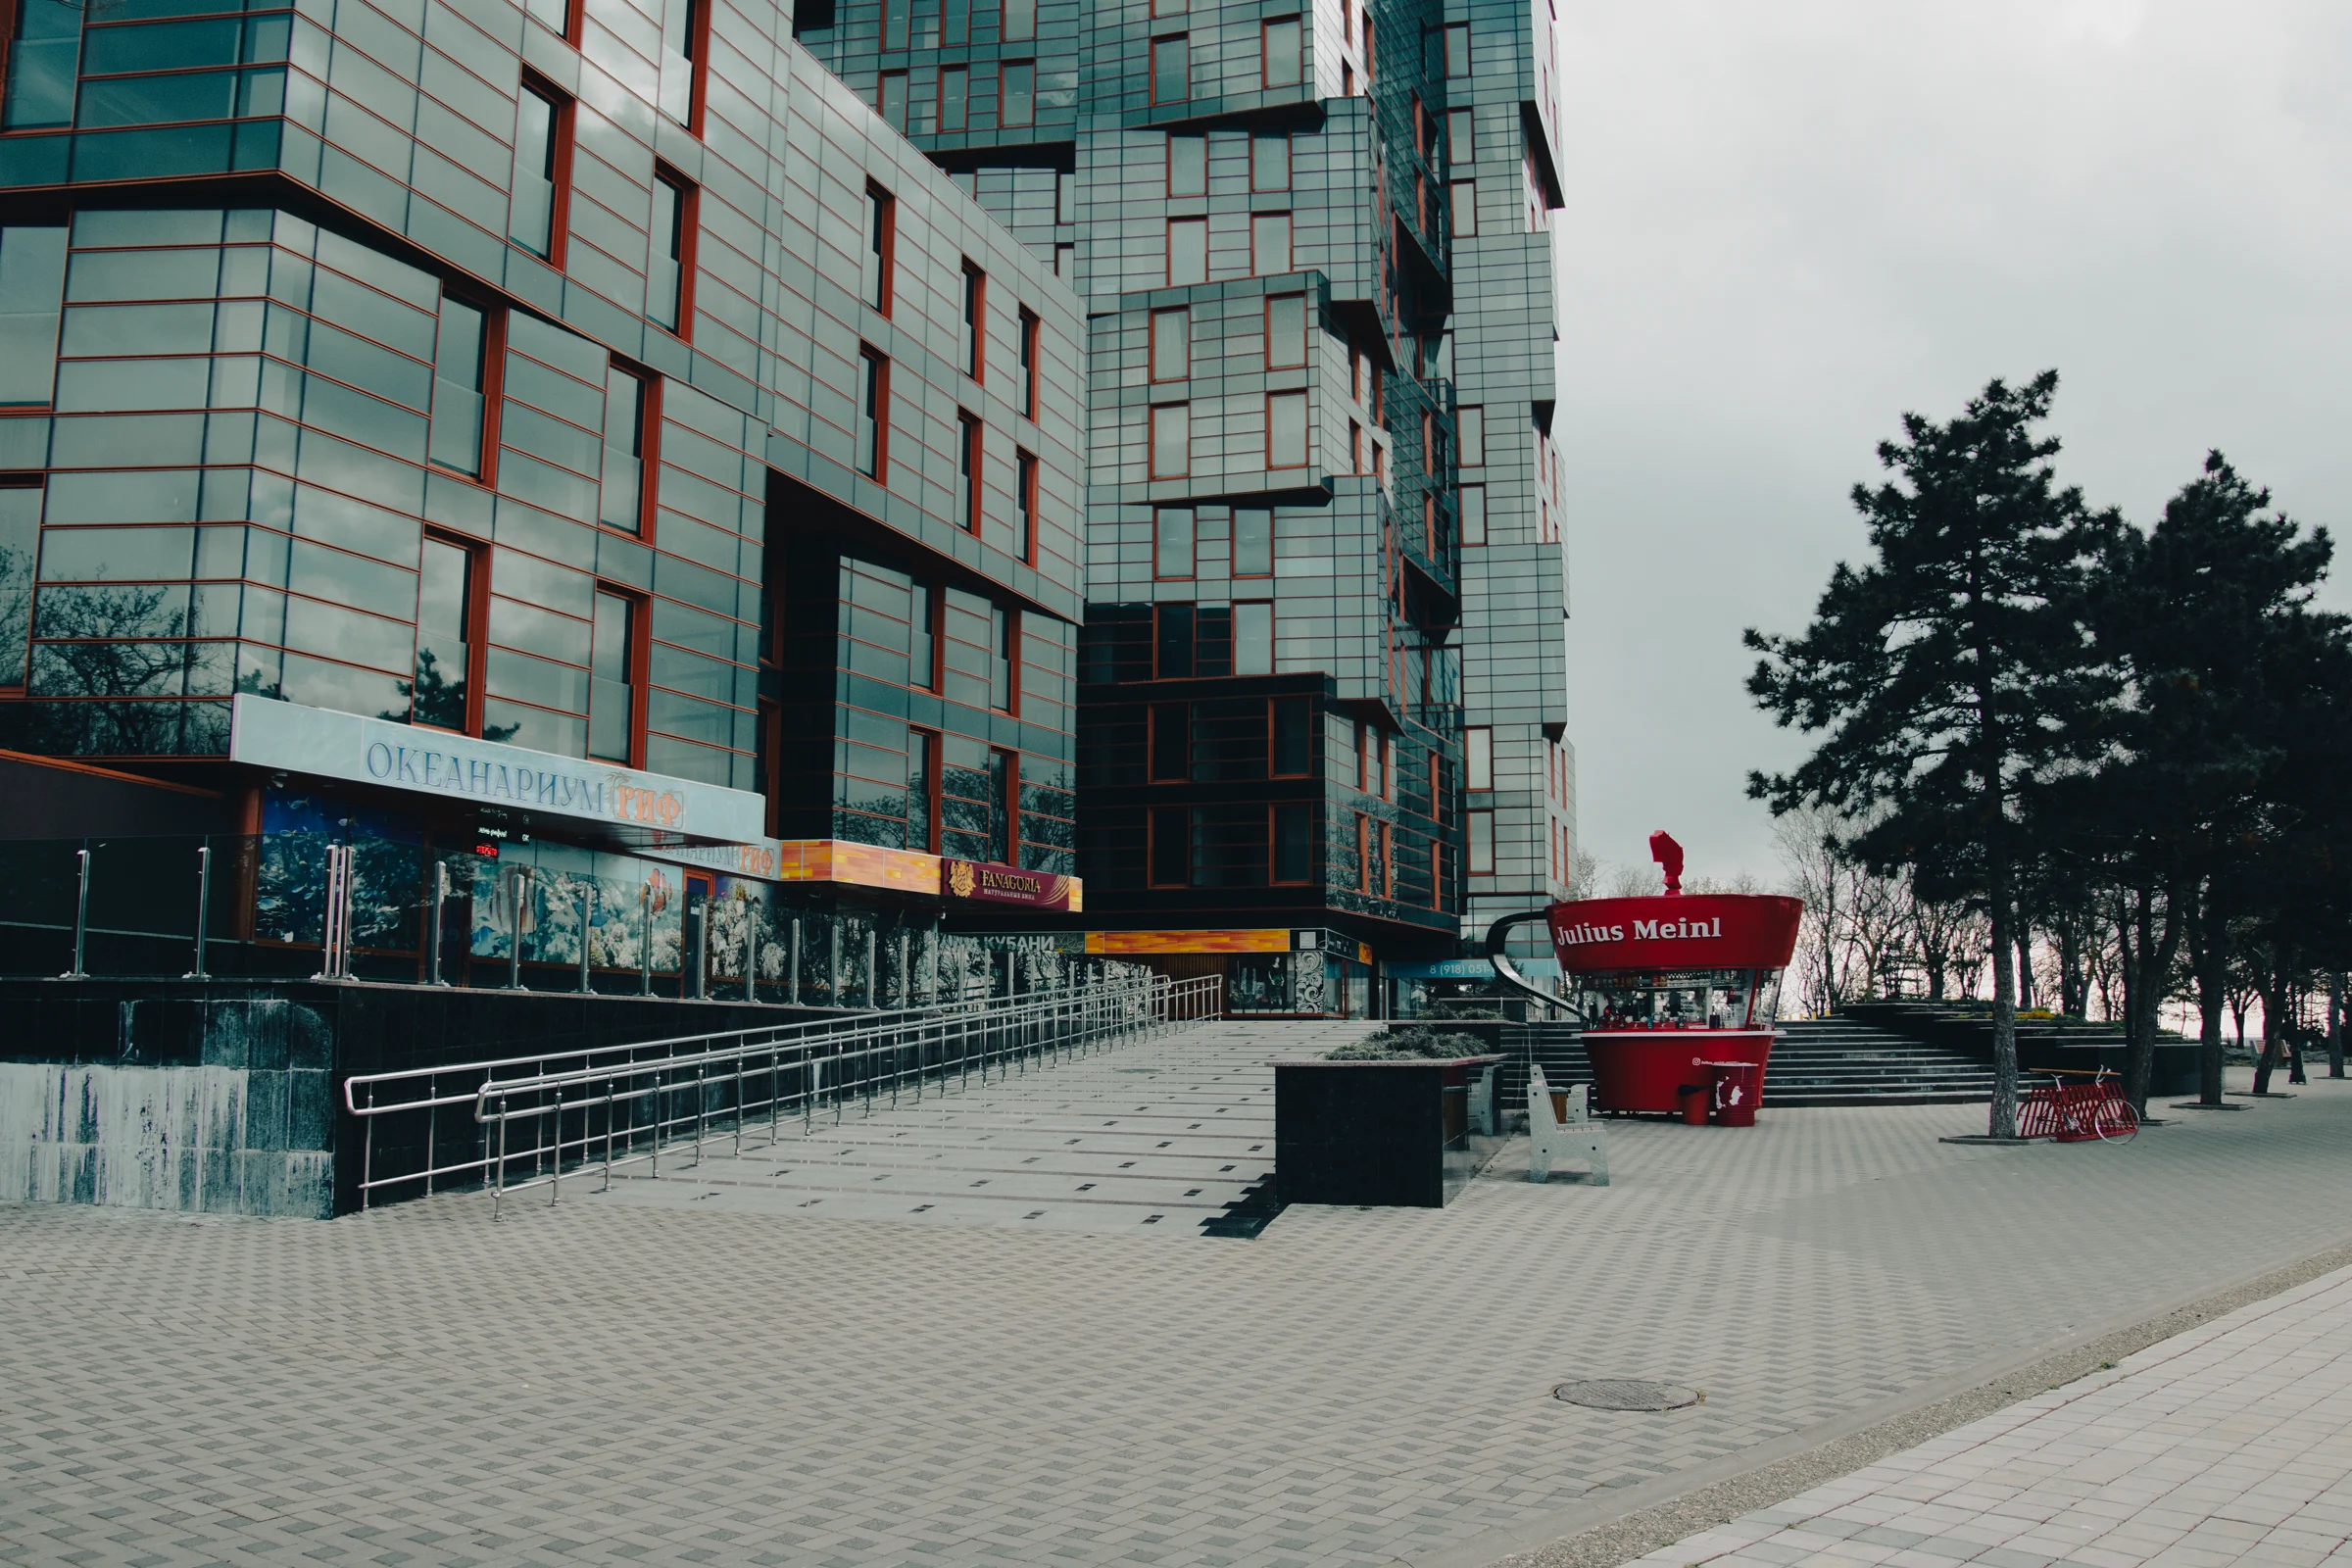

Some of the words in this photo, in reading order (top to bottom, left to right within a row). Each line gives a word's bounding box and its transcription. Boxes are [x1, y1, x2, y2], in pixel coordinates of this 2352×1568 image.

[367, 742, 604, 812] ОКЕАНАРИУМ
[617, 785, 680, 825] РИФ
[740, 845, 773, 875] РИФ
[982, 870, 1041, 893] FANAGORIA
[983, 935, 1054, 951] КУБАНИ
[1557, 922, 1624, 947] Julius
[1632, 917, 1722, 940] Meinl
[1429, 964, 1437, 975] 8
[1440, 964, 1465, 977] (918)
[1468, 963, 1494, 975] 051-
